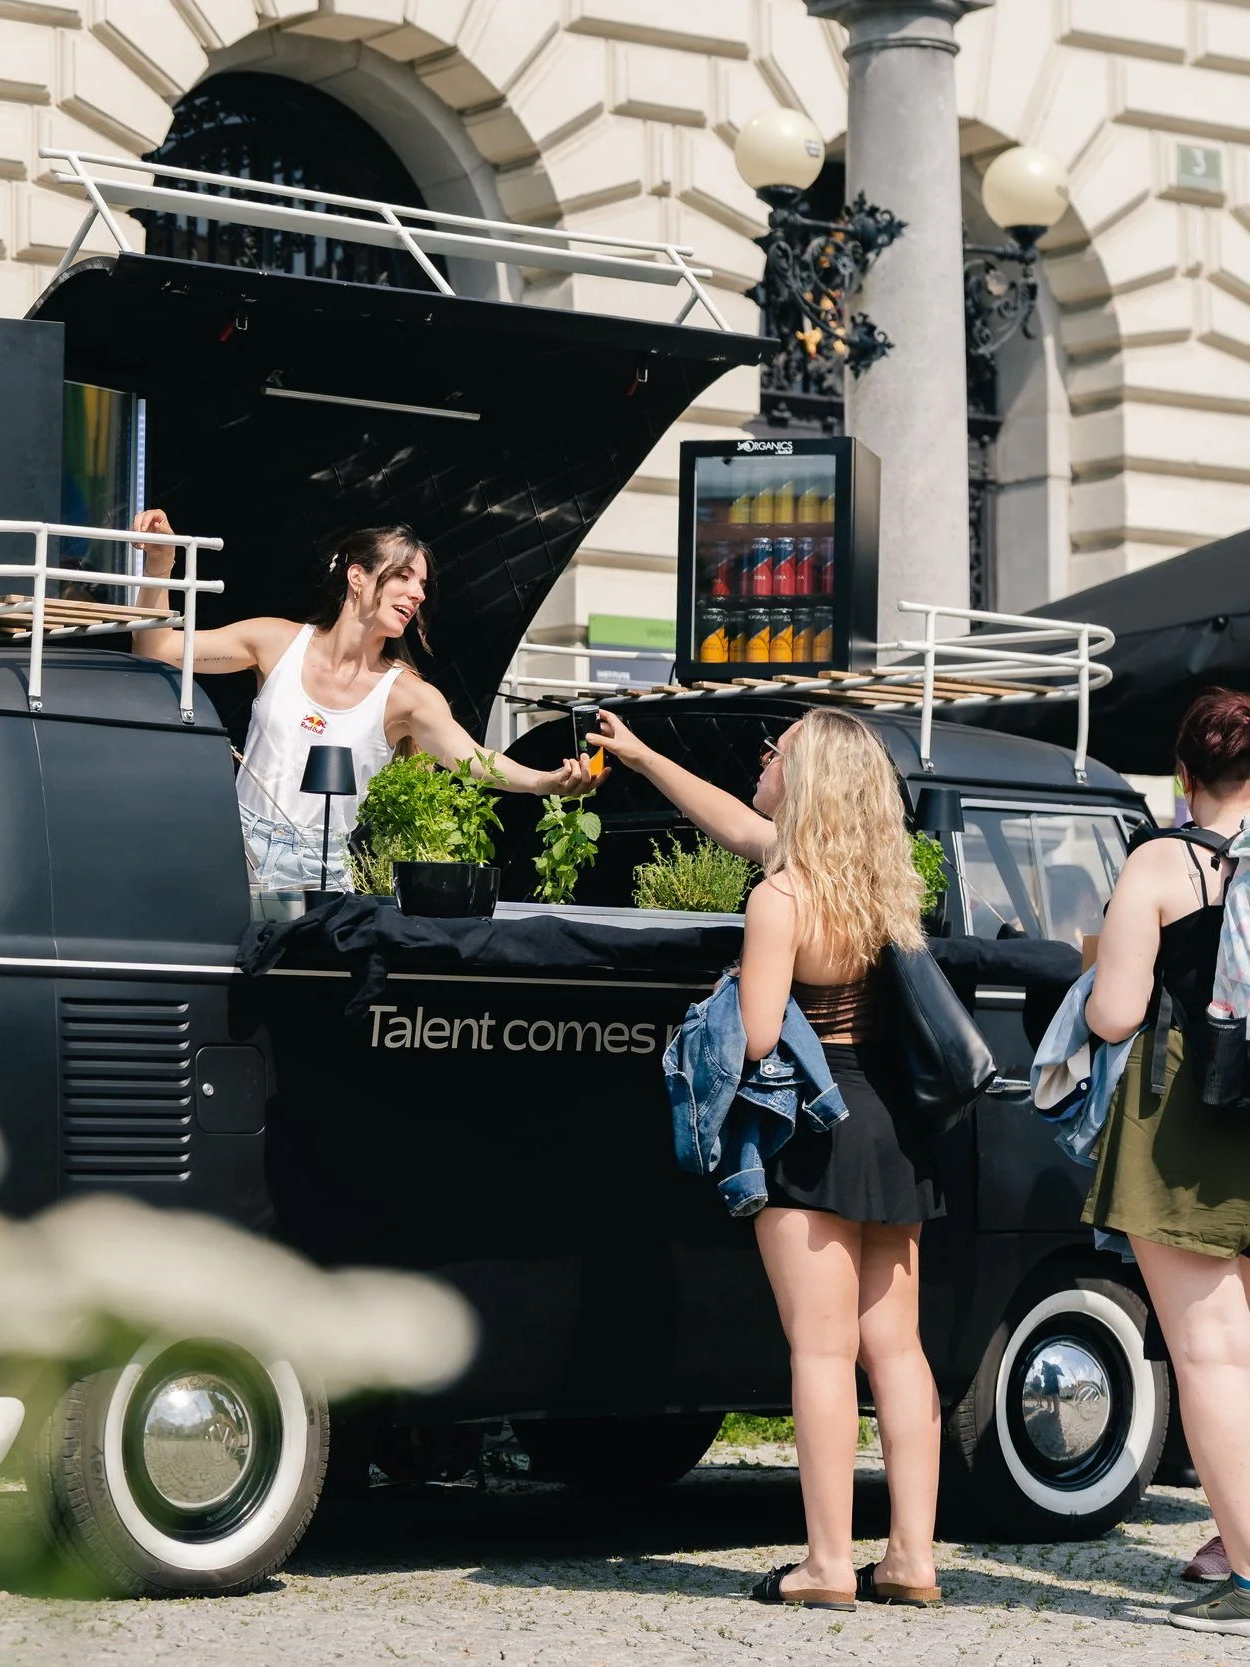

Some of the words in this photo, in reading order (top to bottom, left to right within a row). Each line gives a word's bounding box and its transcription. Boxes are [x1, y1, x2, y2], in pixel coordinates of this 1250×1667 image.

[1192, 148, 1206, 176] 3
[744, 440, 793, 452] ORGANICS
[368, 1005, 496, 1050] Talent
[503, 1019, 656, 1054] comes
